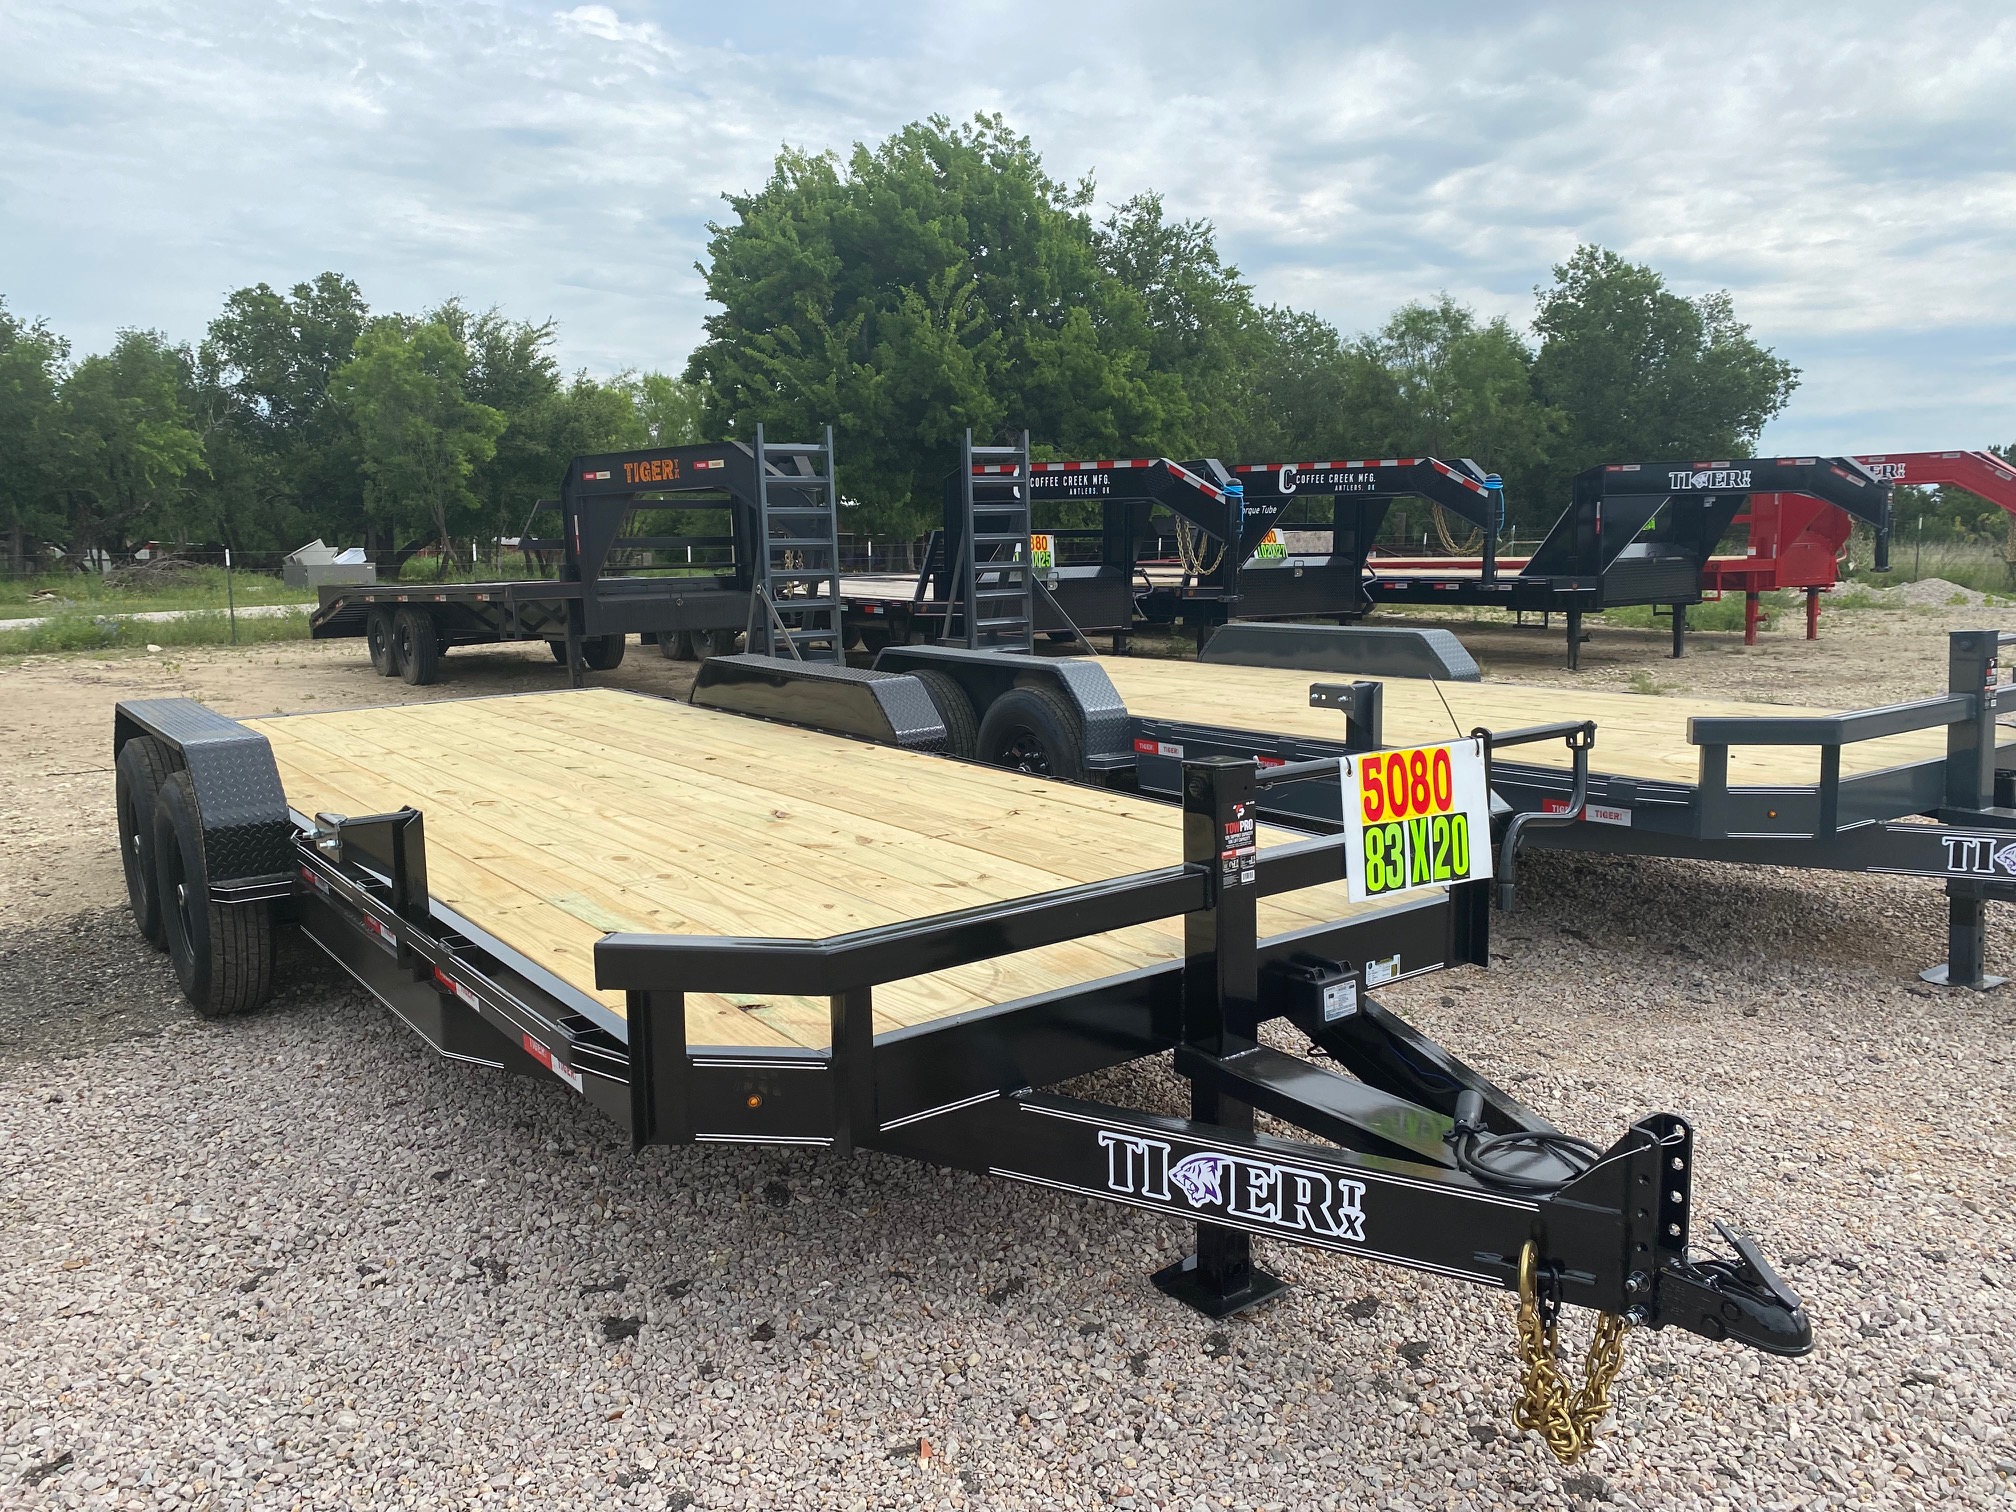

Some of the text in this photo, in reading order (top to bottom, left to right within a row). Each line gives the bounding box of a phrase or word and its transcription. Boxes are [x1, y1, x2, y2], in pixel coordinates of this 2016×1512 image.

[624, 459, 674, 483] TIGER
[1296, 474, 1325, 485] COFFEE
[1328, 473, 1354, 484] CREEK
[1030, 476, 1059, 488] COFFEE
[1062, 474, 1089, 487] CREEK
[1243, 505, 1277, 517] orque Tube
[1361, 747, 1454, 823] 5080
[1364, 813, 1470, 893] 83X20
